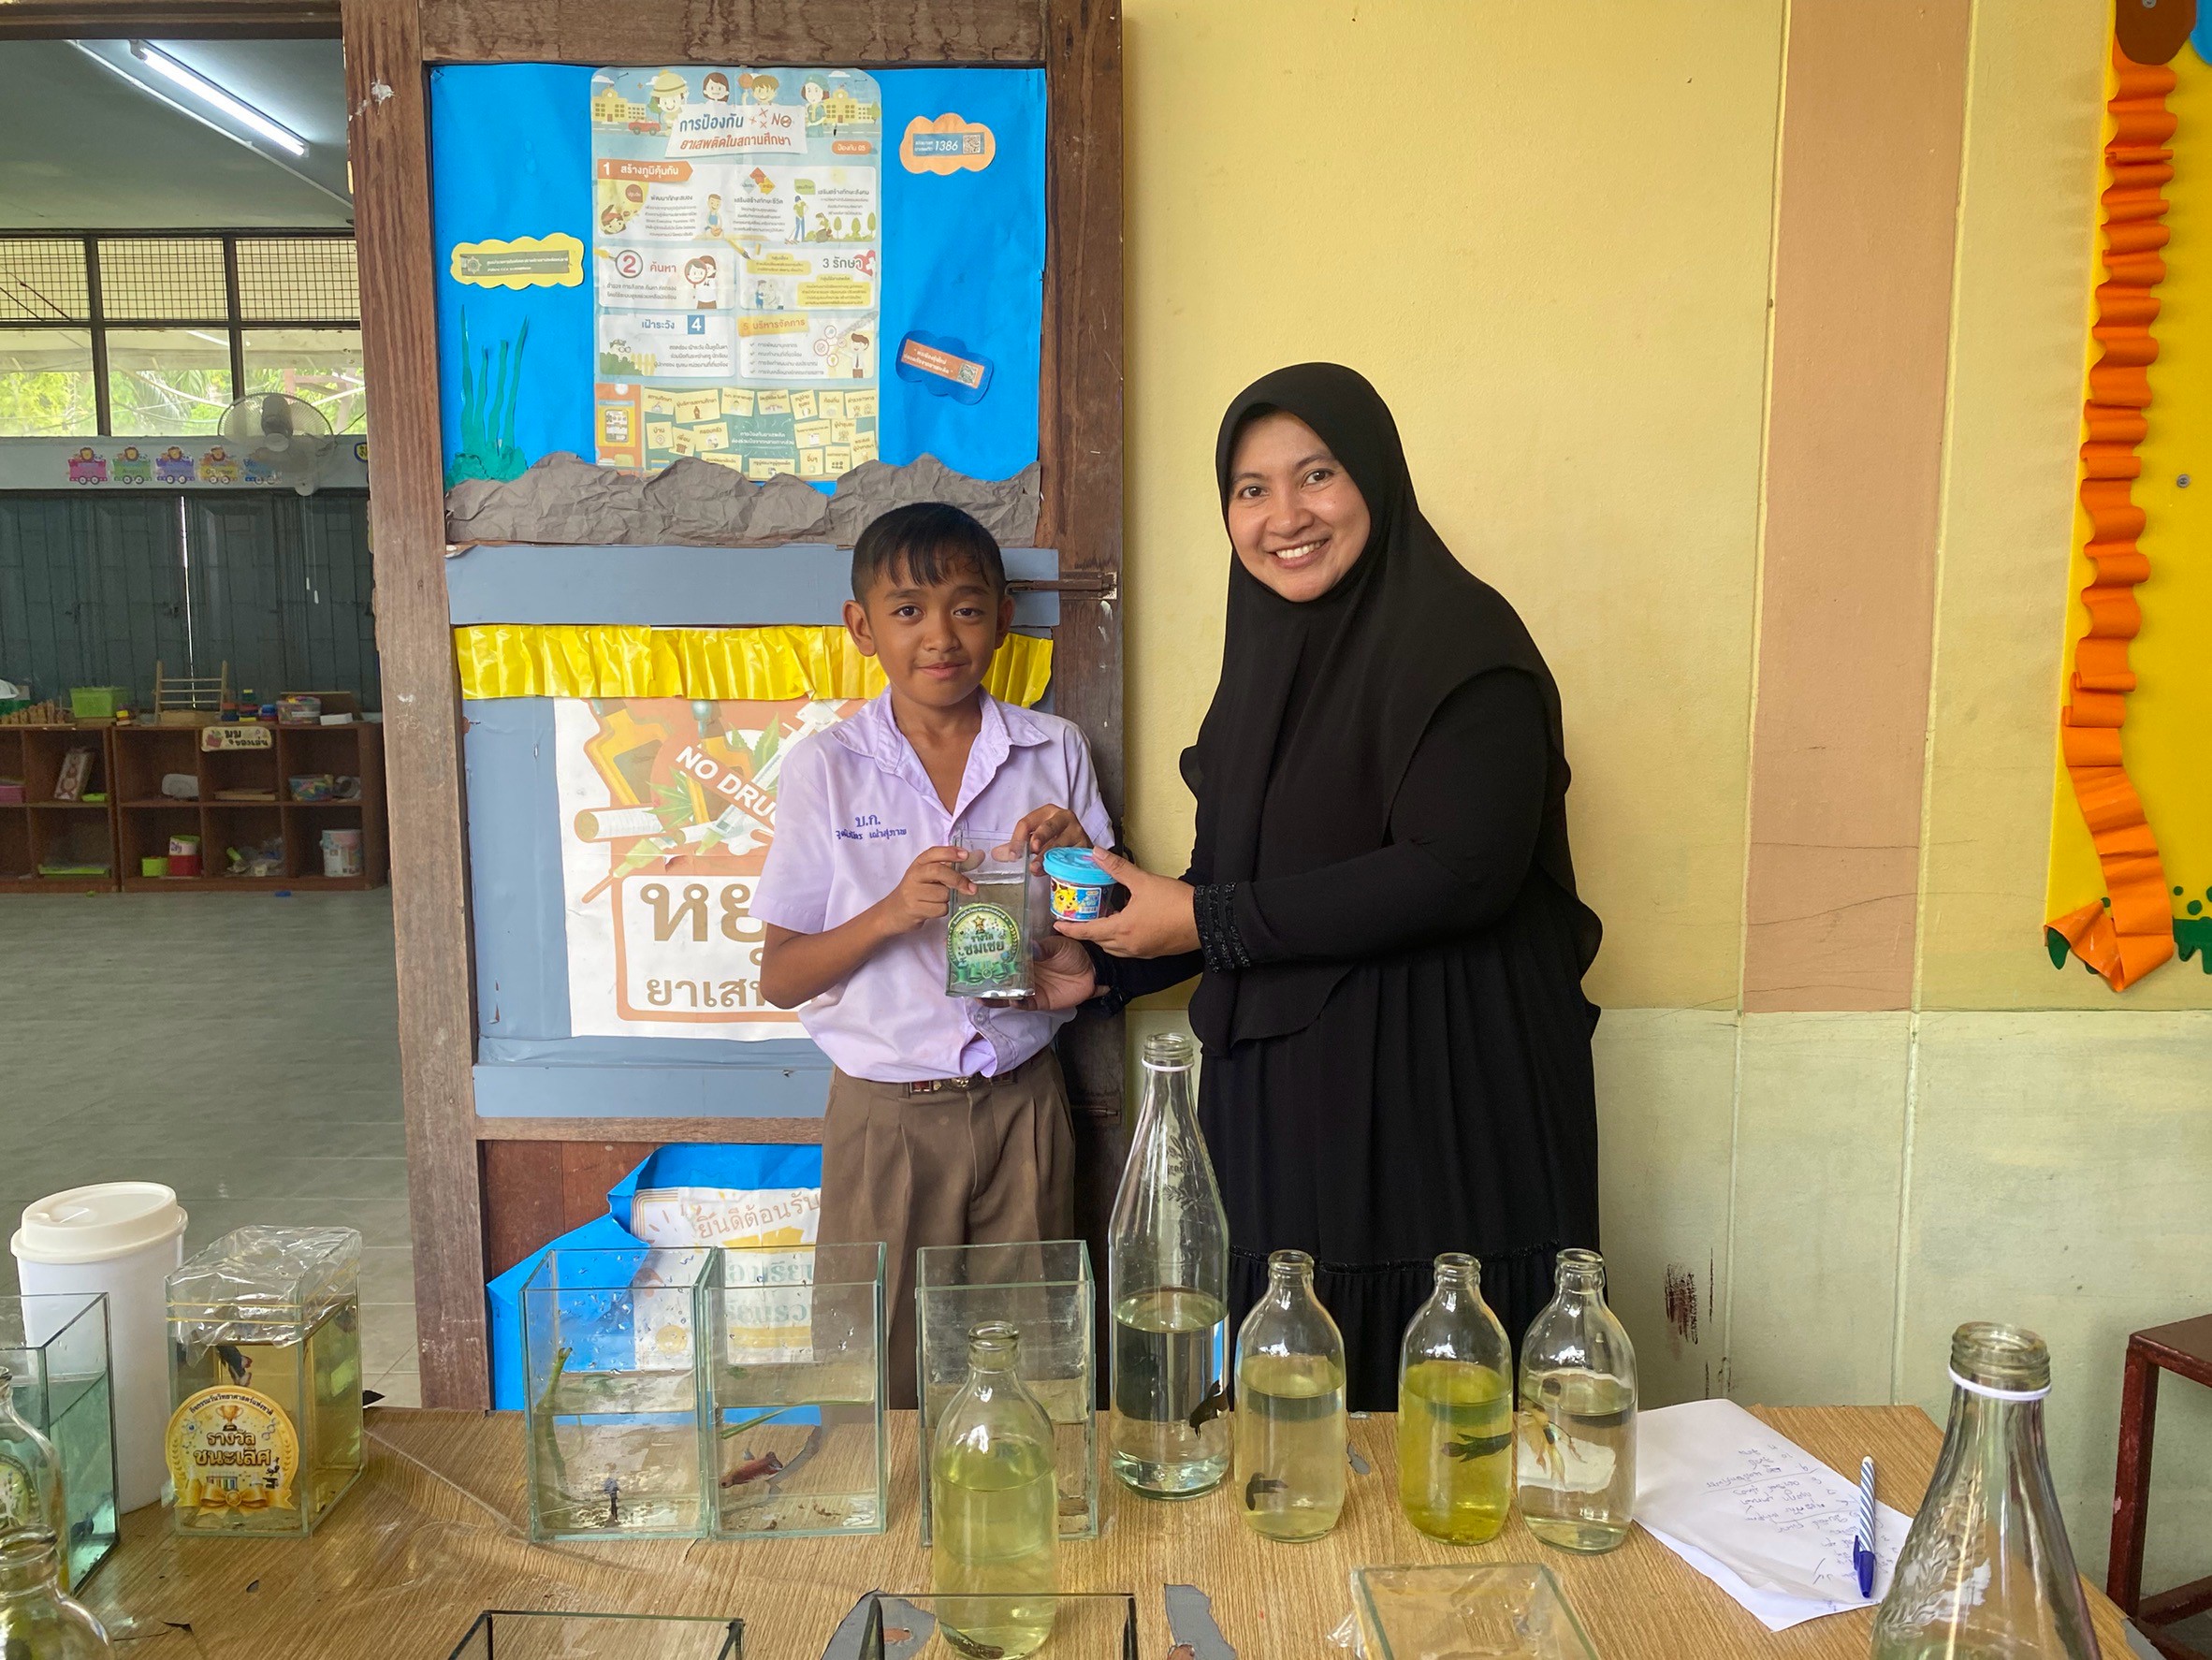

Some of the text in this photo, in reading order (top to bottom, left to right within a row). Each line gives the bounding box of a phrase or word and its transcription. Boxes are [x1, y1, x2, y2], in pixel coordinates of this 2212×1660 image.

[679, 113, 744, 132] การป้องกัน
[680, 135, 792, 150] ยาเสพติดในสถานศึกษา
[936, 140, 958, 152] 1386
[604, 162, 678, 178] 1 สร้างภูมิคุ้มกัน
[623, 255, 677, 273] 2 ค้นหา
[822, 255, 862, 269] 3 รักษา
[642, 317, 702, 331] เฝ้าระวัง 4
[753, 318, 806, 329] บริหารจัดการ
[676, 746, 720, 780] NO
[855, 814, 880, 828] บ.ก.
[971, 931, 994, 942] รางวัล
[964, 940, 1005, 955] ชมเชย
[697, 1191, 820, 1240] ยินดีต้อนรับ
[189, 1392, 274, 1417] กิจกรรมวันวิทยาศาสตร์แห่งชาติ
[207, 1430, 257, 1447] รางวัล
[193, 1447, 271, 1467] ชนะเลิศ
